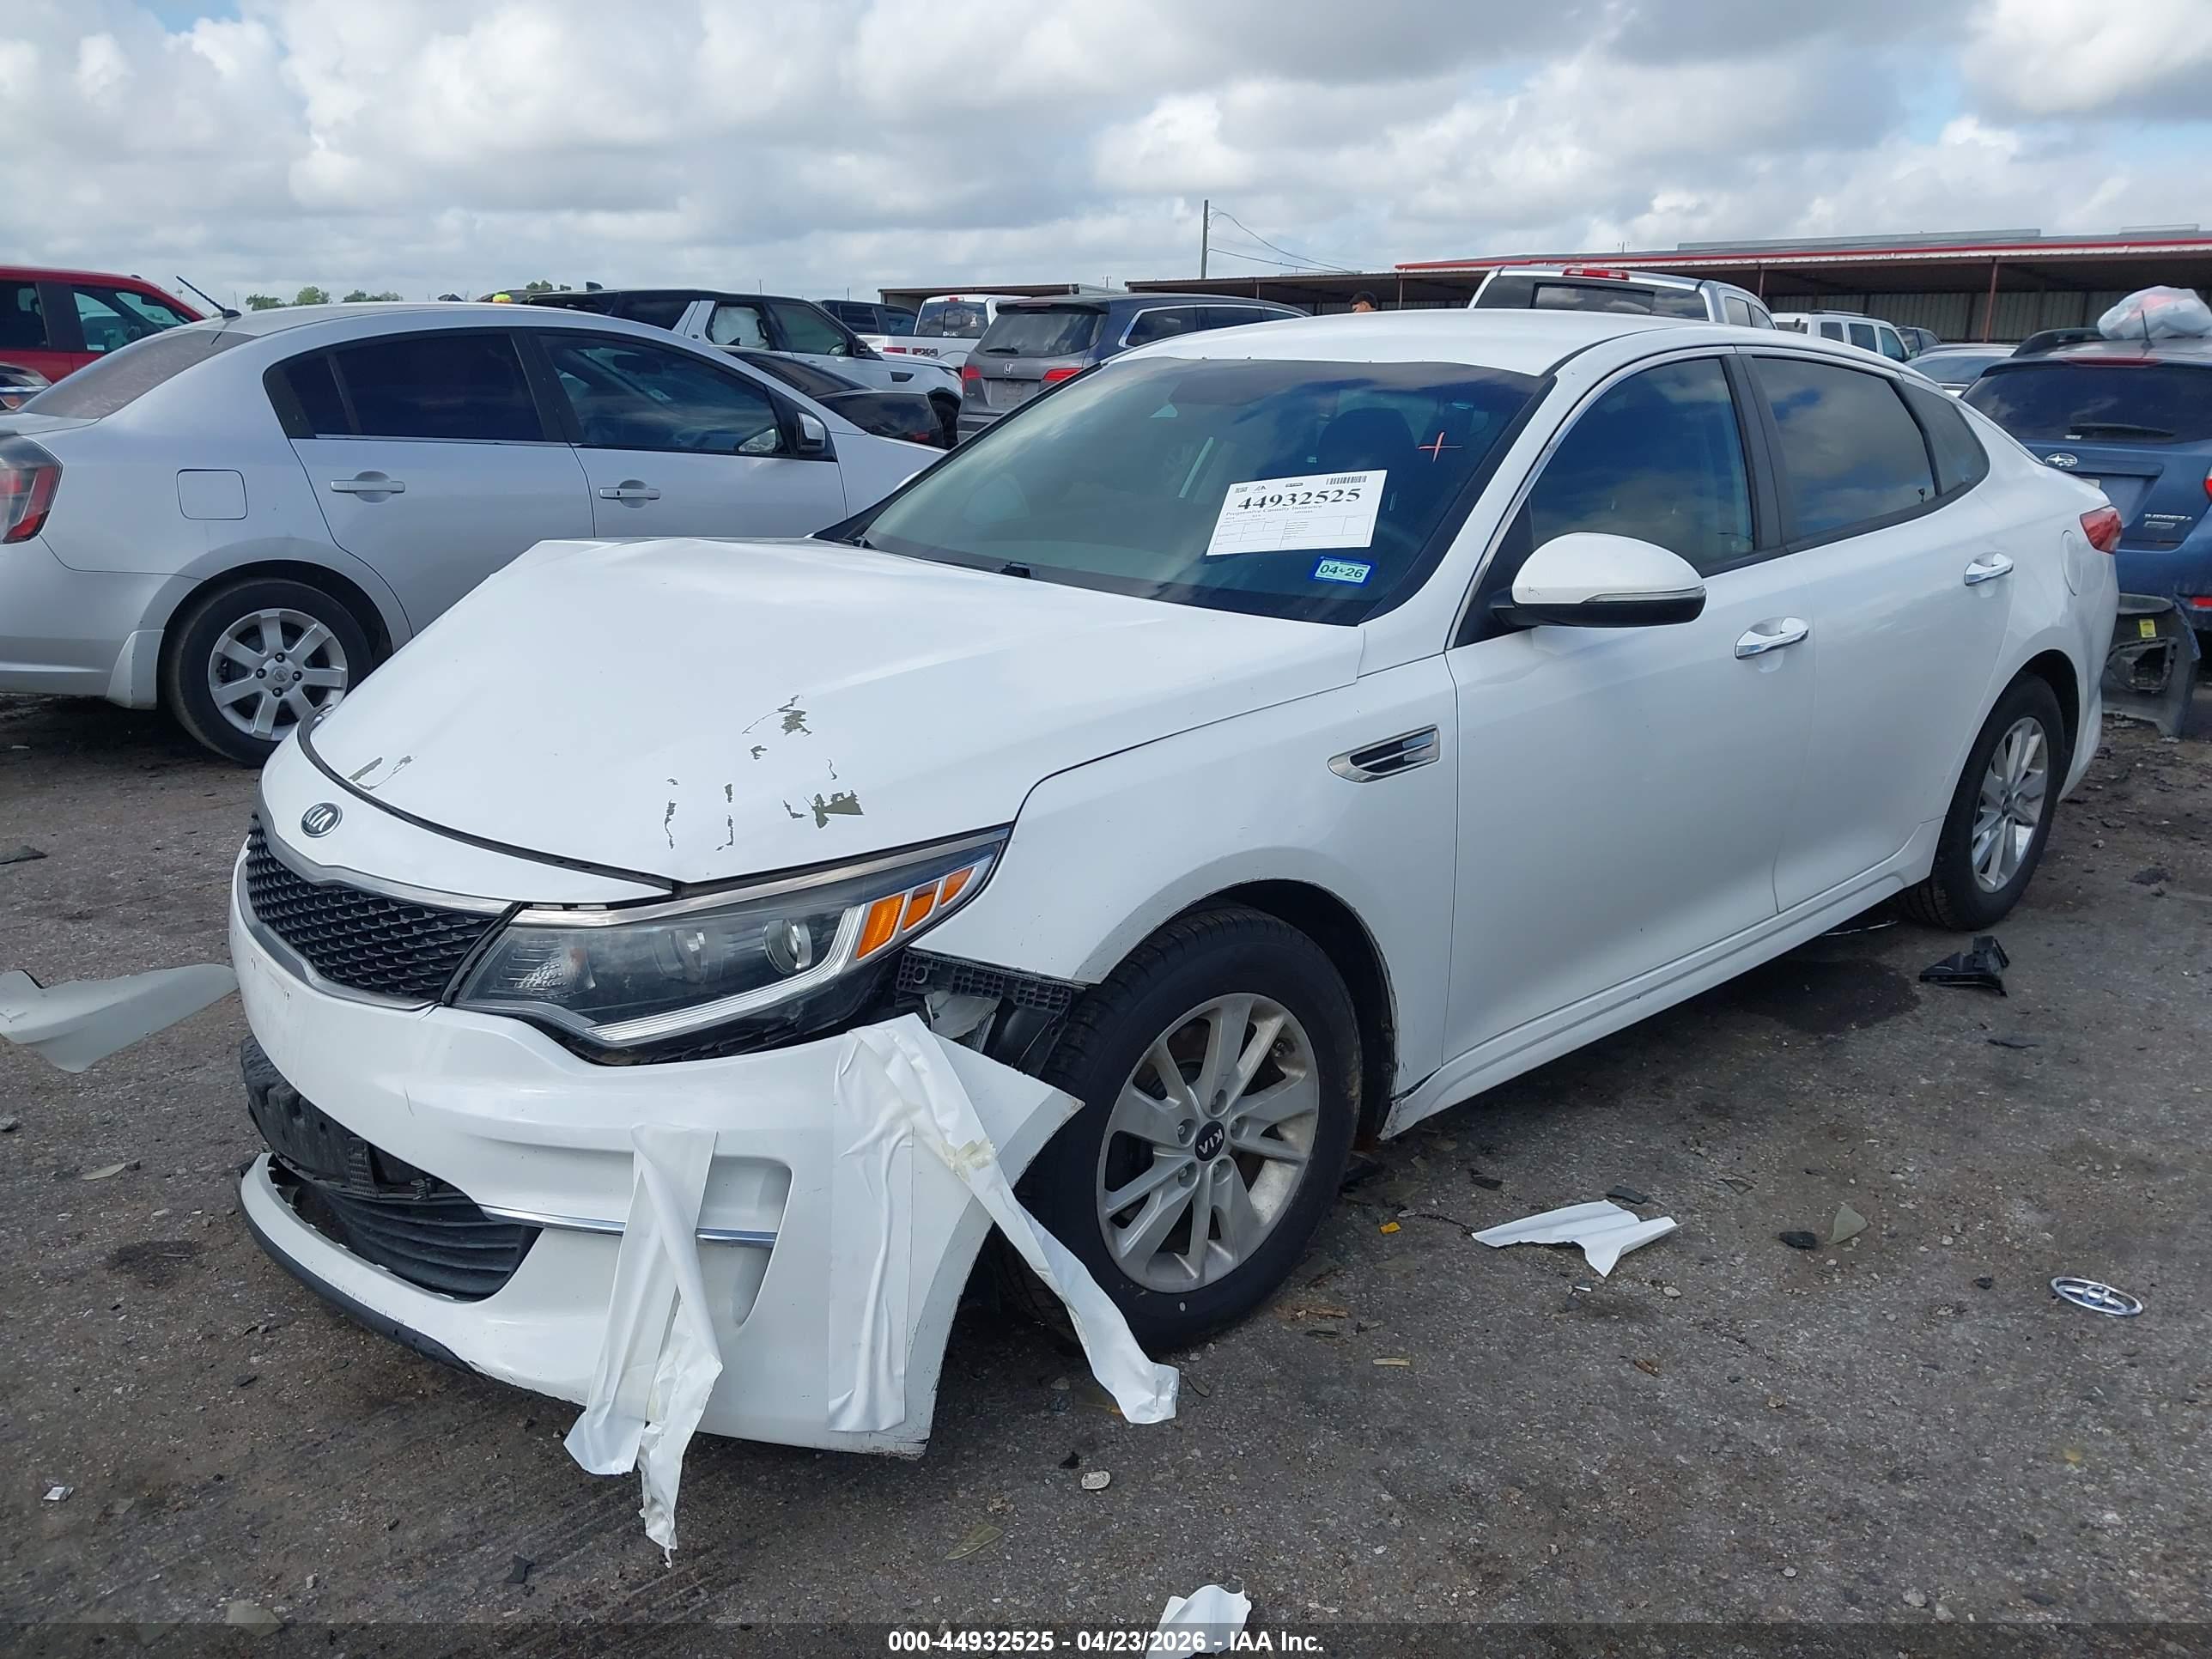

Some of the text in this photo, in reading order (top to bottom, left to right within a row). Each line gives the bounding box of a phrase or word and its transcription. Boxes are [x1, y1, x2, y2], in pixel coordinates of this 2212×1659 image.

[1237, 489, 1361, 509] 44932525
[1320, 565, 1364, 578] 04 26
[303, 804, 334, 831] KIA
[1198, 1128, 1223, 1154] KIA
